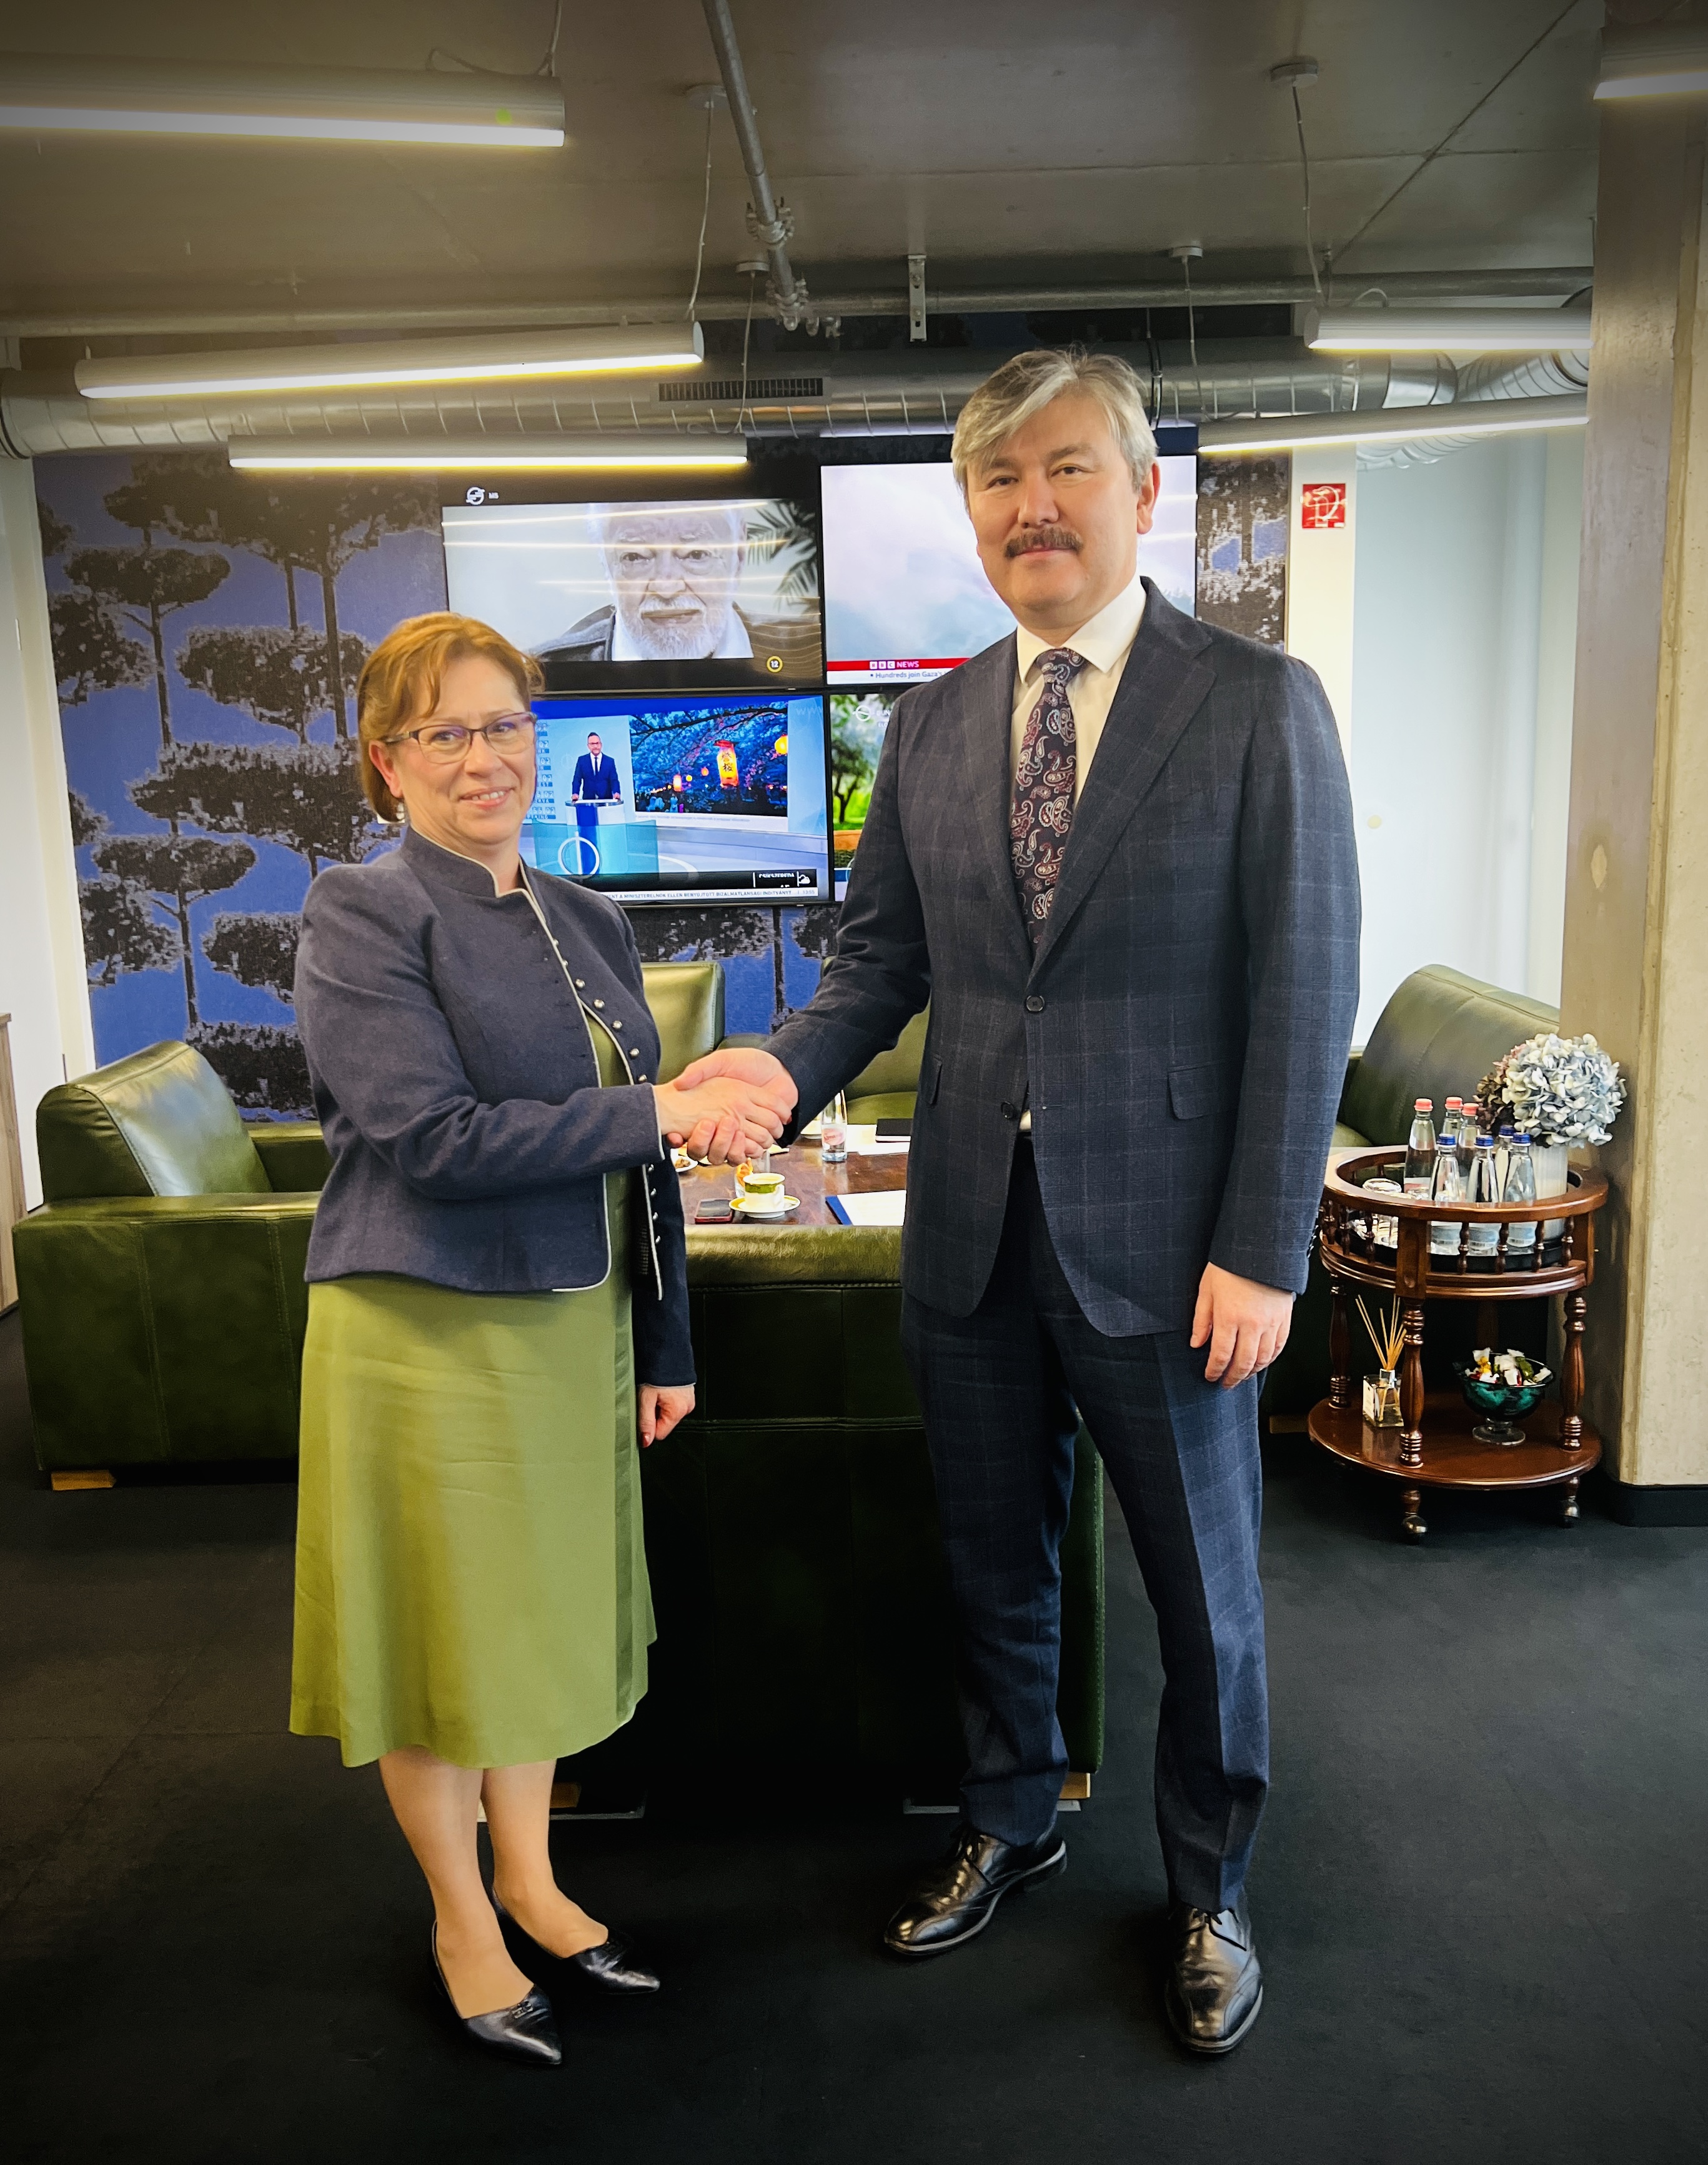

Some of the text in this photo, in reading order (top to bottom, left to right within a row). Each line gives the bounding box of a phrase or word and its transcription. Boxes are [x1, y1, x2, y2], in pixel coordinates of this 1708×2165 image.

[770, 660, 779, 668] 12
[870, 661, 895, 669] BBC
[908, 670, 921, 679] join
